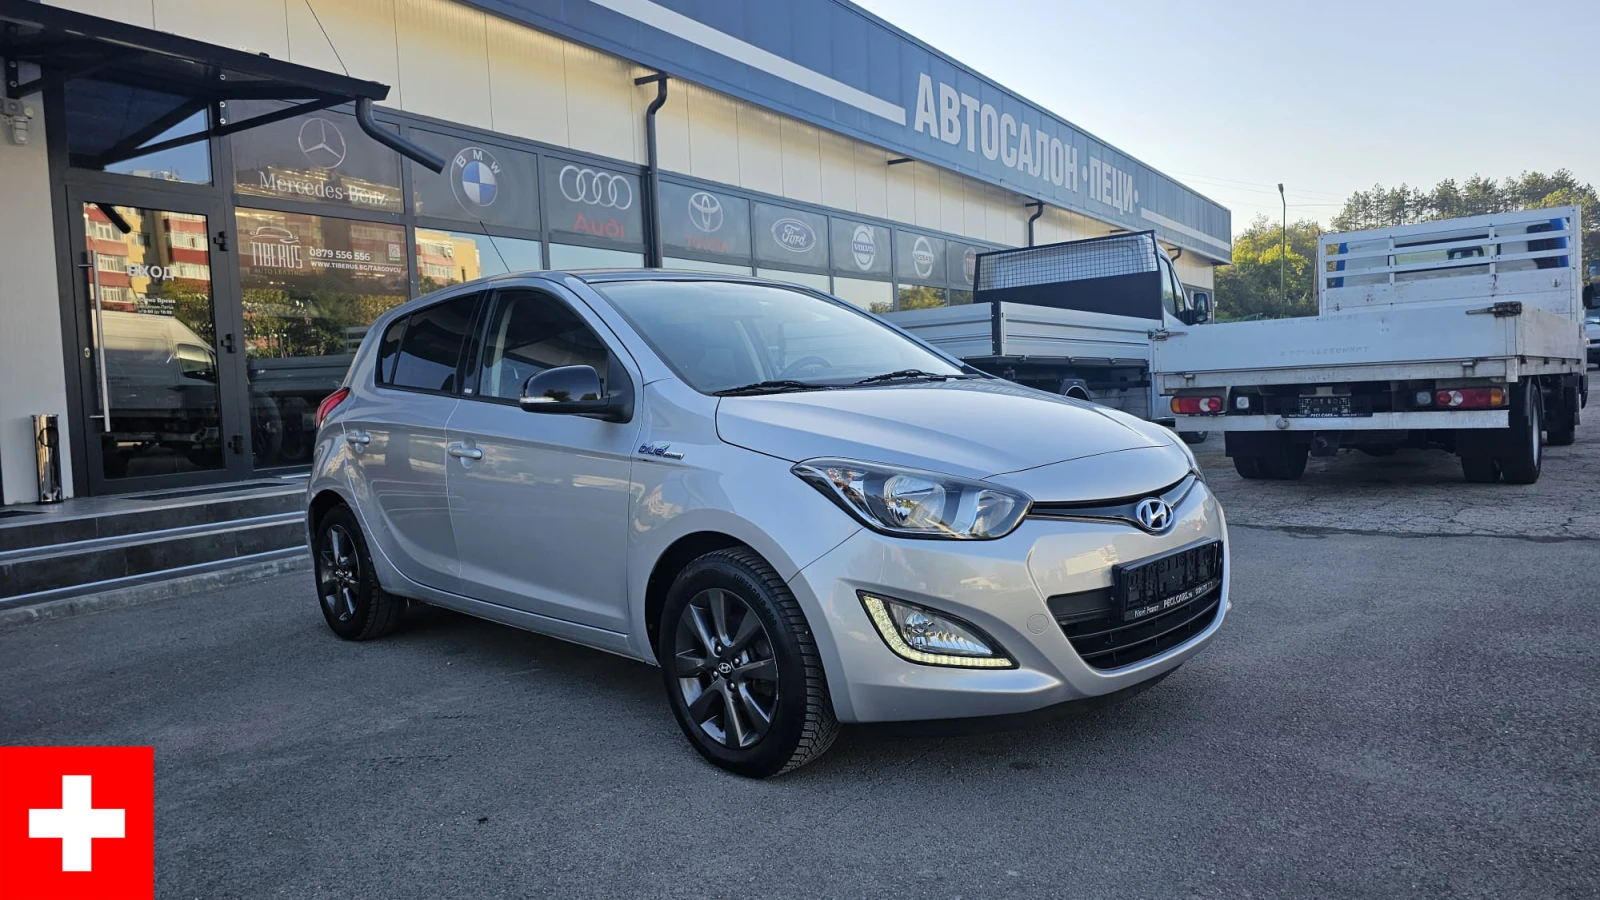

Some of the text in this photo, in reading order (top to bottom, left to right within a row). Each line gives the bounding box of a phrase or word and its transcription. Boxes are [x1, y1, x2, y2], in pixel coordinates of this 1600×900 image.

[914, 72, 1133, 215] АВТОСАЛОН ПЕЦИ
[455, 149, 501, 175] BMW
[259, 171, 389, 206] Mercedes-Benz
[572, 213, 625, 238] Audi
[782, 224, 807, 247] Ford
[249, 242, 303, 269] TIBERUS
[309, 248, 371, 261] 0879 556 556
[853, 243, 874, 254] VOLVO
[128, 264, 175, 281] ВХОД
